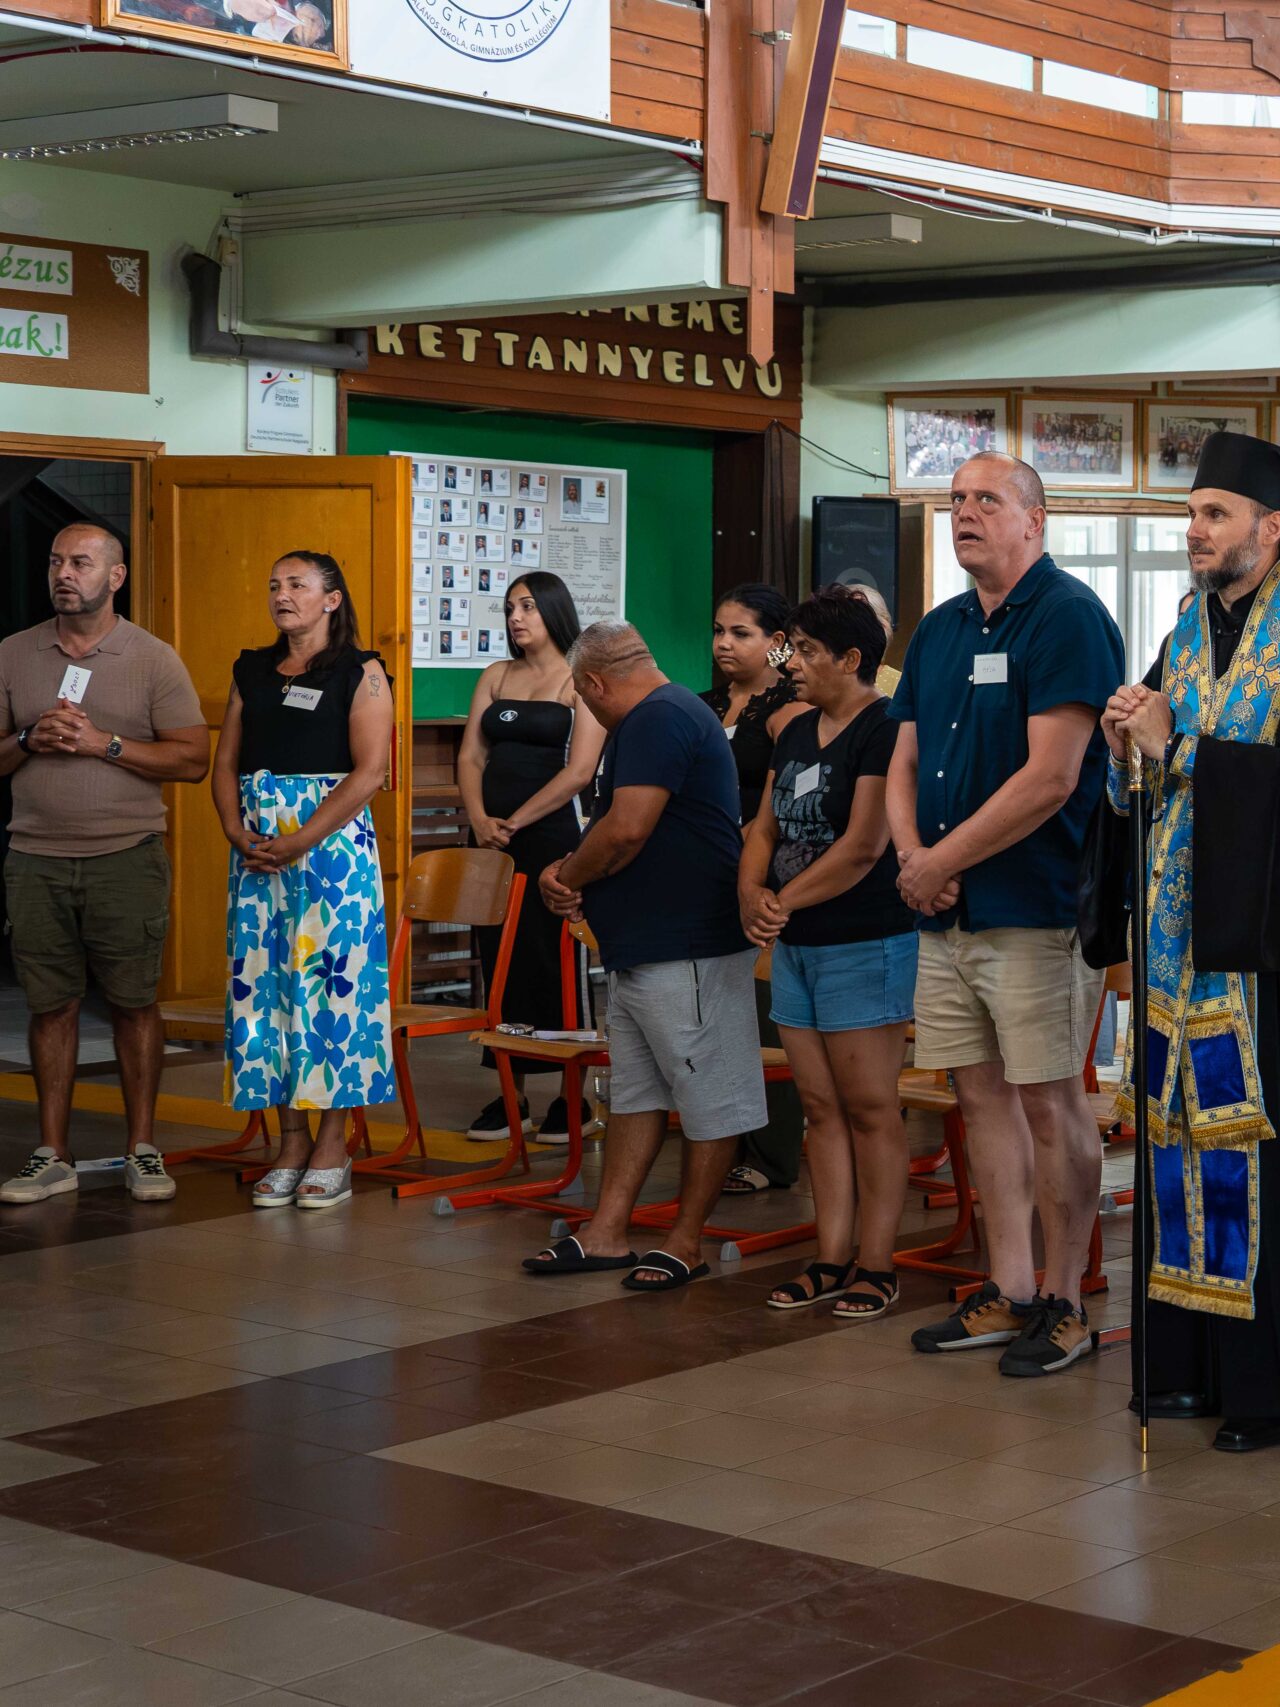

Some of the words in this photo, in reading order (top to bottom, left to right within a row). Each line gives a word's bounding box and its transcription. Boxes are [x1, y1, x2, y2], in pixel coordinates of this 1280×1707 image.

[426, 0, 557, 38] GKATOLIK
[470, 43, 515, 56] GIMNÁZIUM
[514, 43, 525, 53] ÉS
[523, 15, 558, 49] KOLLÉGIUM
[275, 393, 300, 404] Partner
